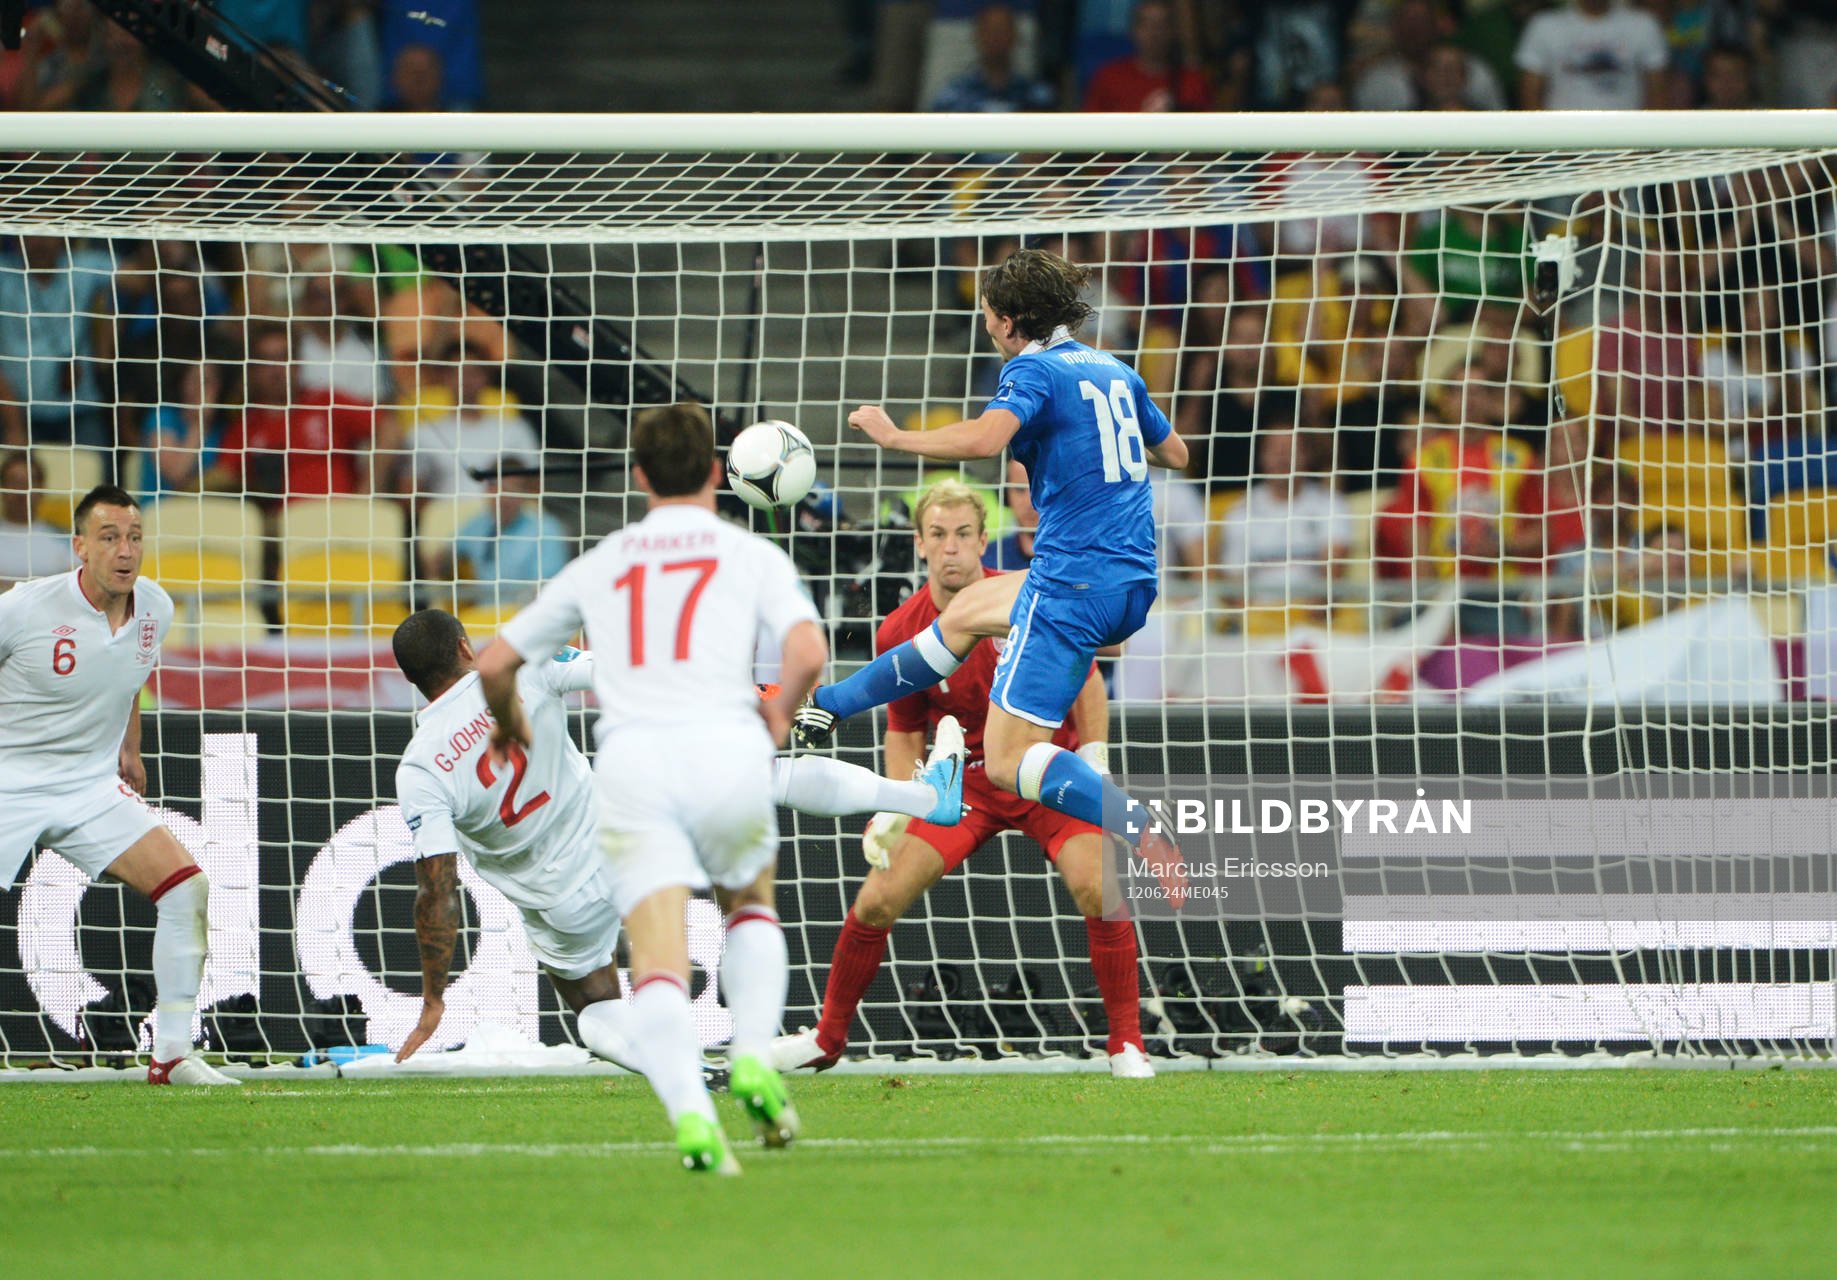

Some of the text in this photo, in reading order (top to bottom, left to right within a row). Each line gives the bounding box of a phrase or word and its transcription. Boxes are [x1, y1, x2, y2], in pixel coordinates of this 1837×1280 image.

[1078, 379, 1148, 483] 18
[53, 638, 77, 676] 6
[613, 557, 720, 668] 17
[476, 738, 551, 829] 2
